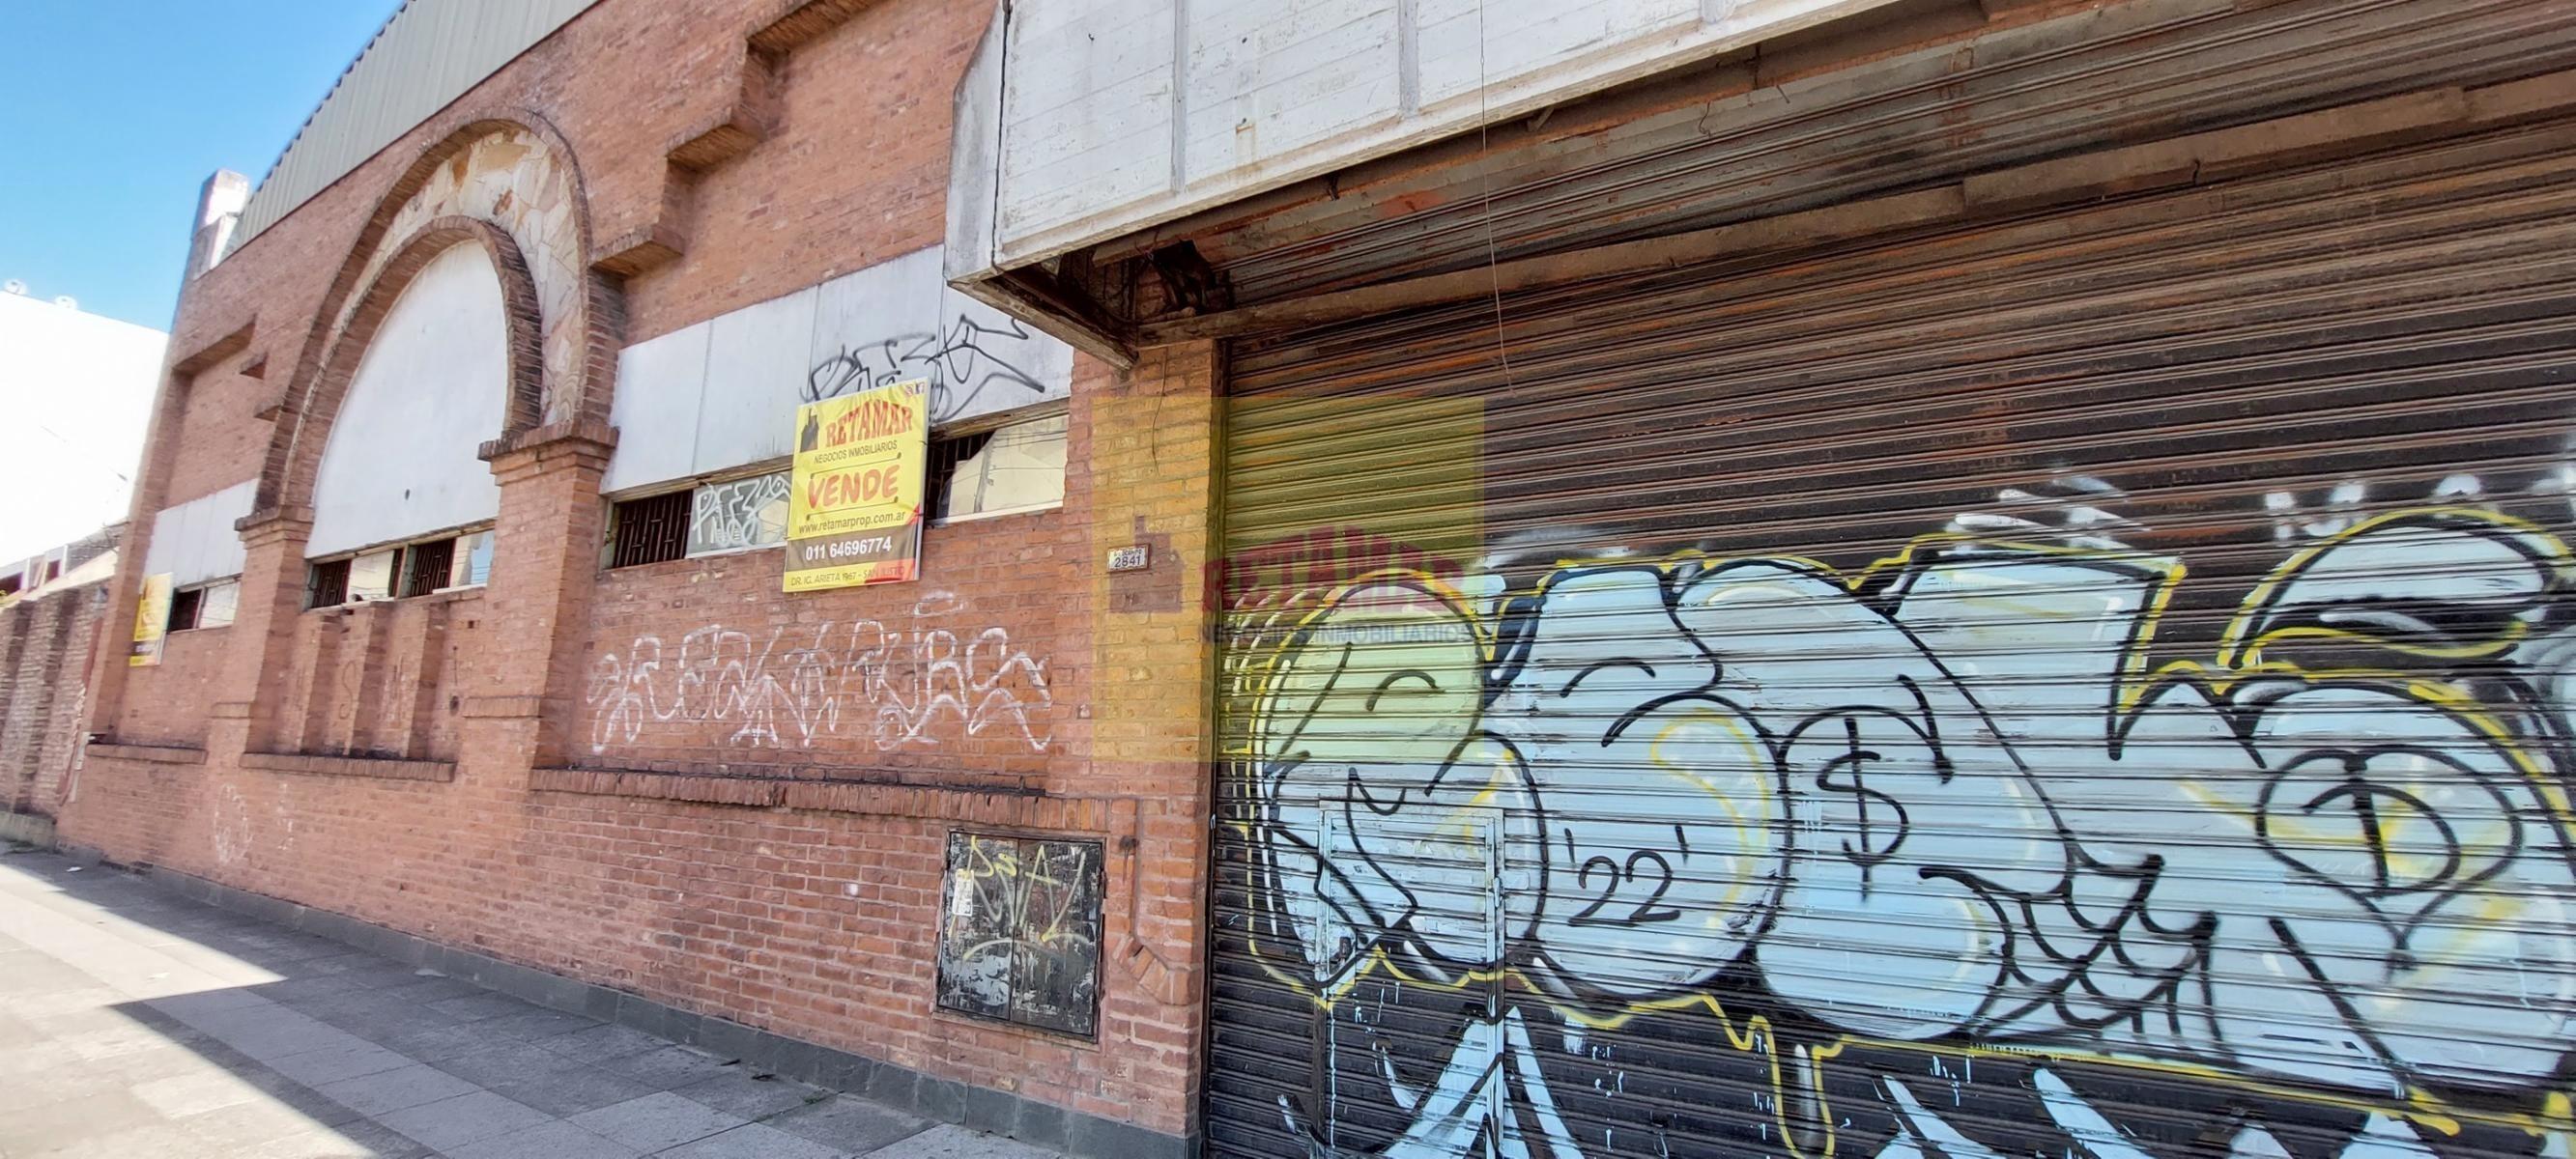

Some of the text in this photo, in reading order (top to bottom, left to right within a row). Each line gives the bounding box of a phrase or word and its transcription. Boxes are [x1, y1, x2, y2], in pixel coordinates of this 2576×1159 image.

[824, 398, 913, 448] RETAMAR
[814, 439, 898, 465] NEGOCIOS INMOBILIARIOS
[808, 464, 901, 510] VENDE
[798, 510, 906, 534] www.retamarprop.com.ar
[806, 536, 892, 560] 011 64696774
[1114, 555, 1141, 568] 2841
